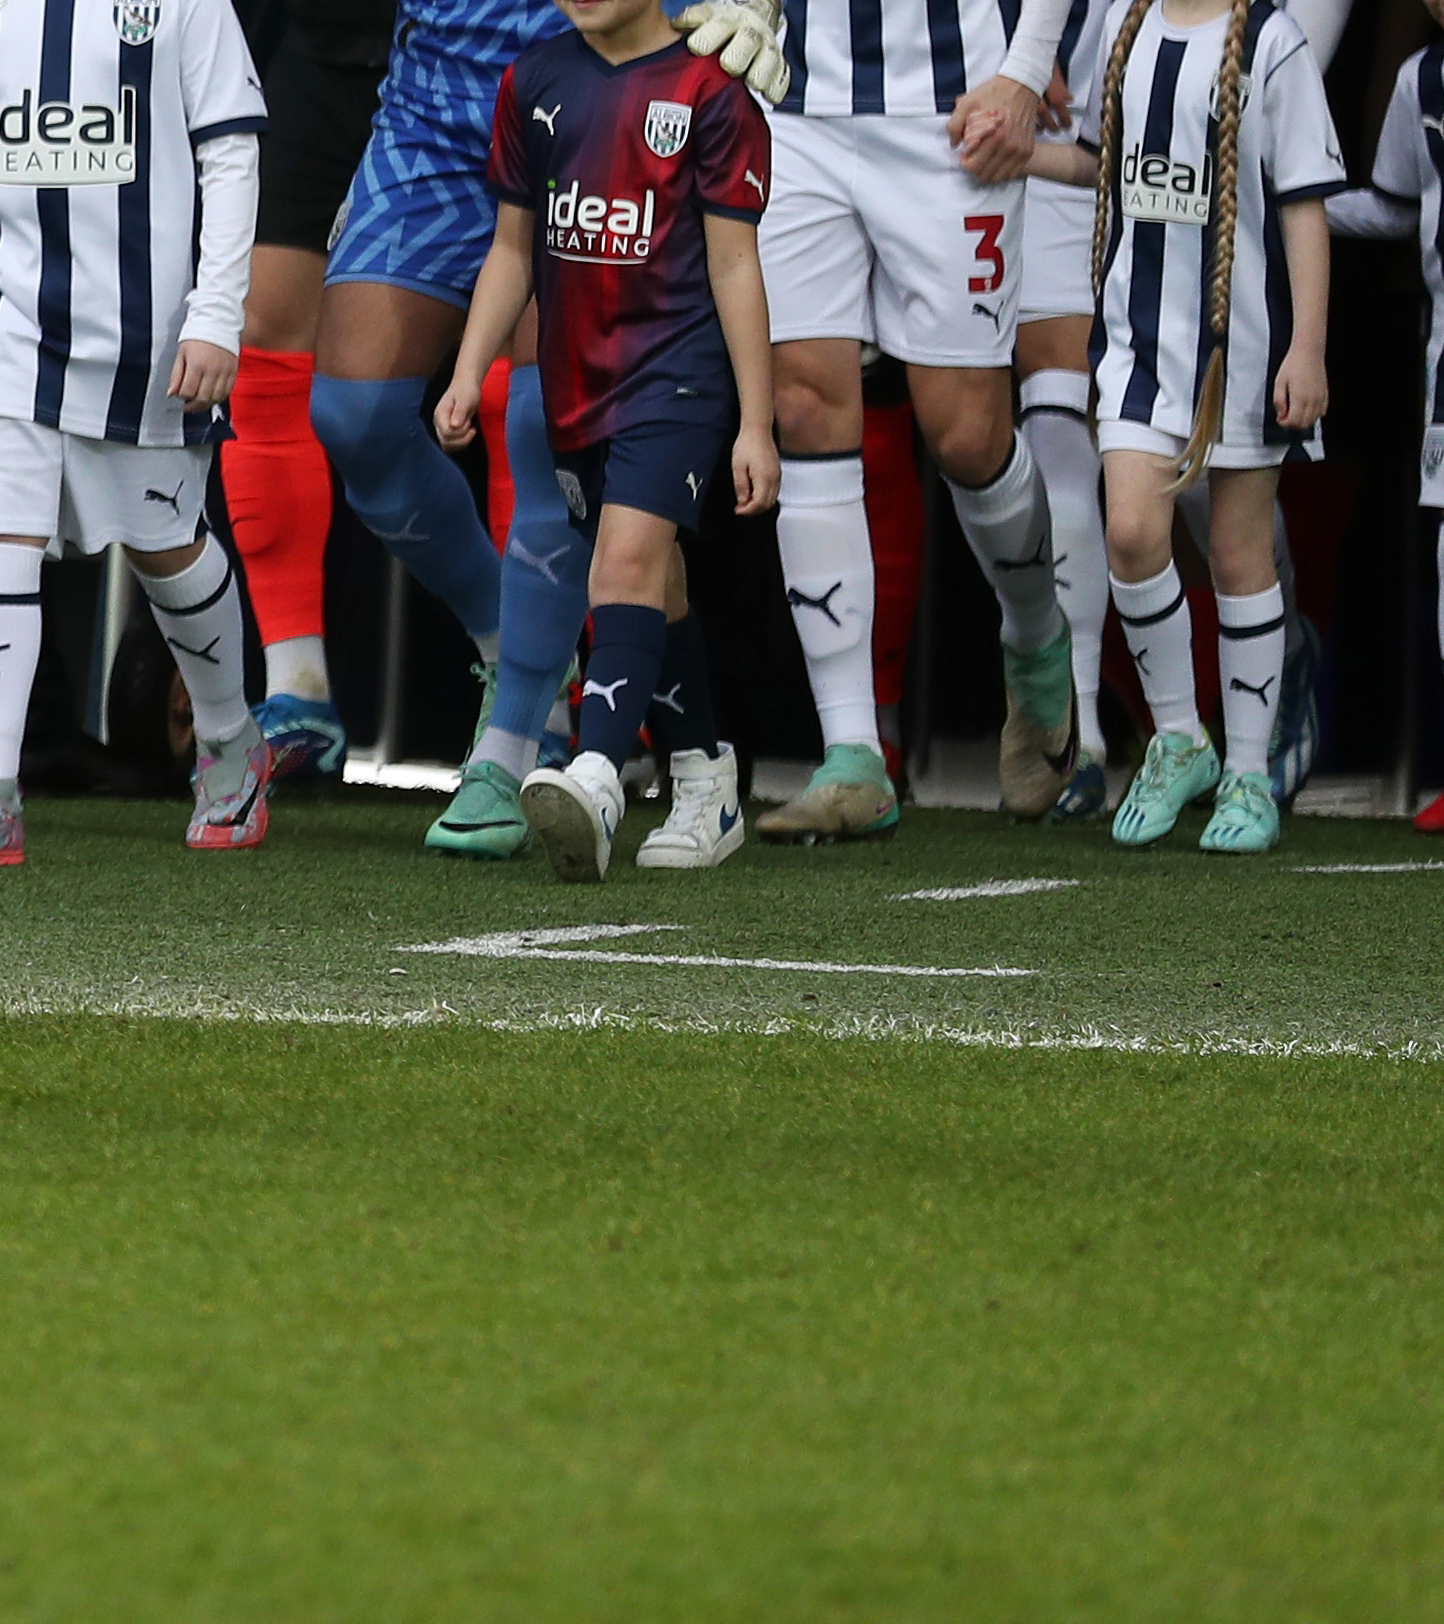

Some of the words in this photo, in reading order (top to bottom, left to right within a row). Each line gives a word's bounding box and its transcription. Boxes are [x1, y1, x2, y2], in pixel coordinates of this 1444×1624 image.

[1123, 143, 1211, 197] deal
[546, 178, 655, 238] ideal
[546, 227, 651, 257] HEATING
[964, 214, 1005, 293] 3
